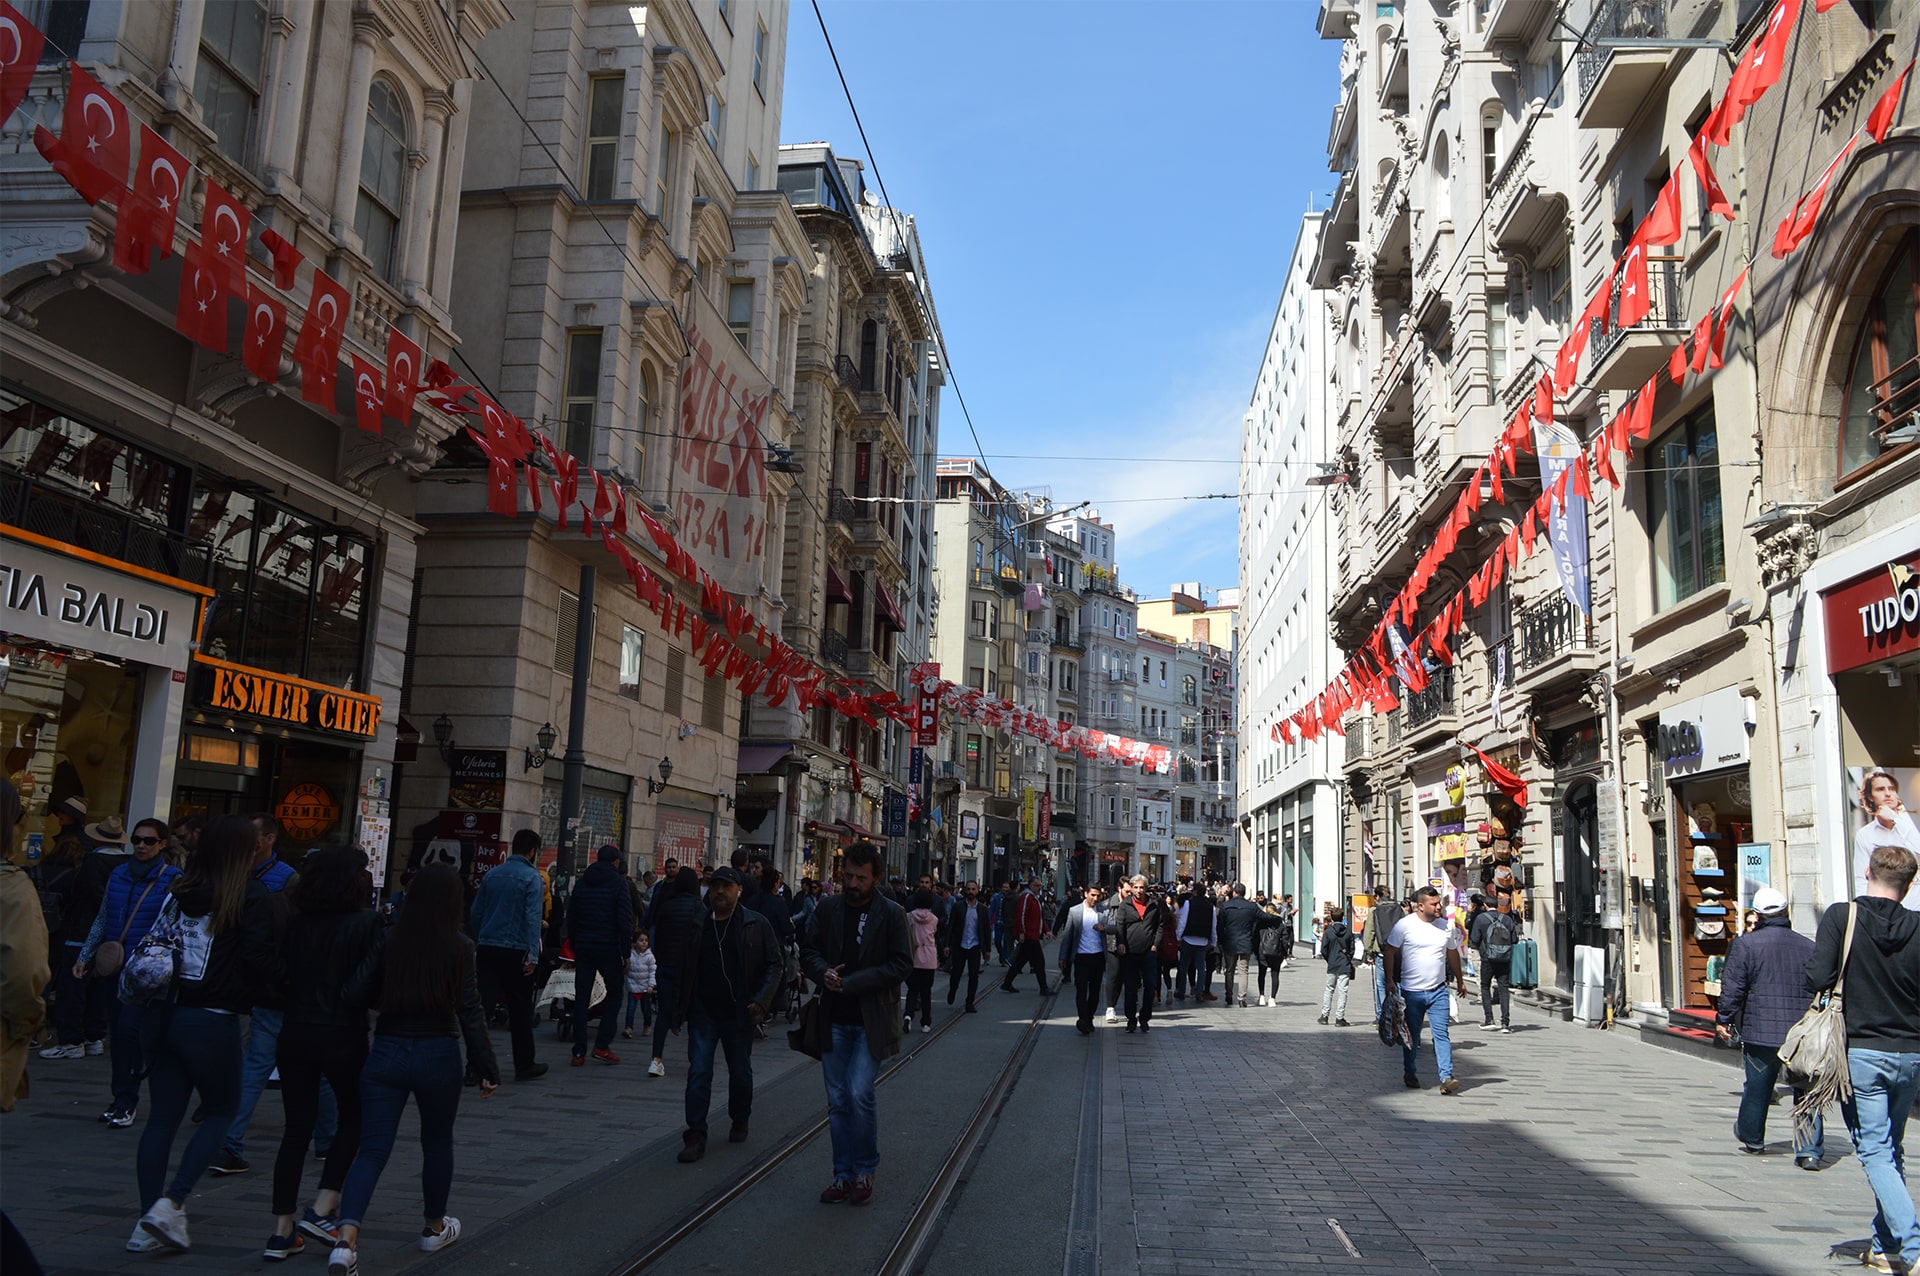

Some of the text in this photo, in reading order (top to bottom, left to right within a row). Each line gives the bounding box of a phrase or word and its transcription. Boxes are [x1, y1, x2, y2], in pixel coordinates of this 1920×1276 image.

[60, 582, 168, 645] BALDI
[1858, 585, 1920, 638] TUDO
[211, 667, 383, 737] ESMER CHEF
[294, 784, 322, 797] CAFE
[282, 805, 331, 818] ESMER
[477, 845, 496, 856] Are
[181, 918, 199, 928] KEEP
